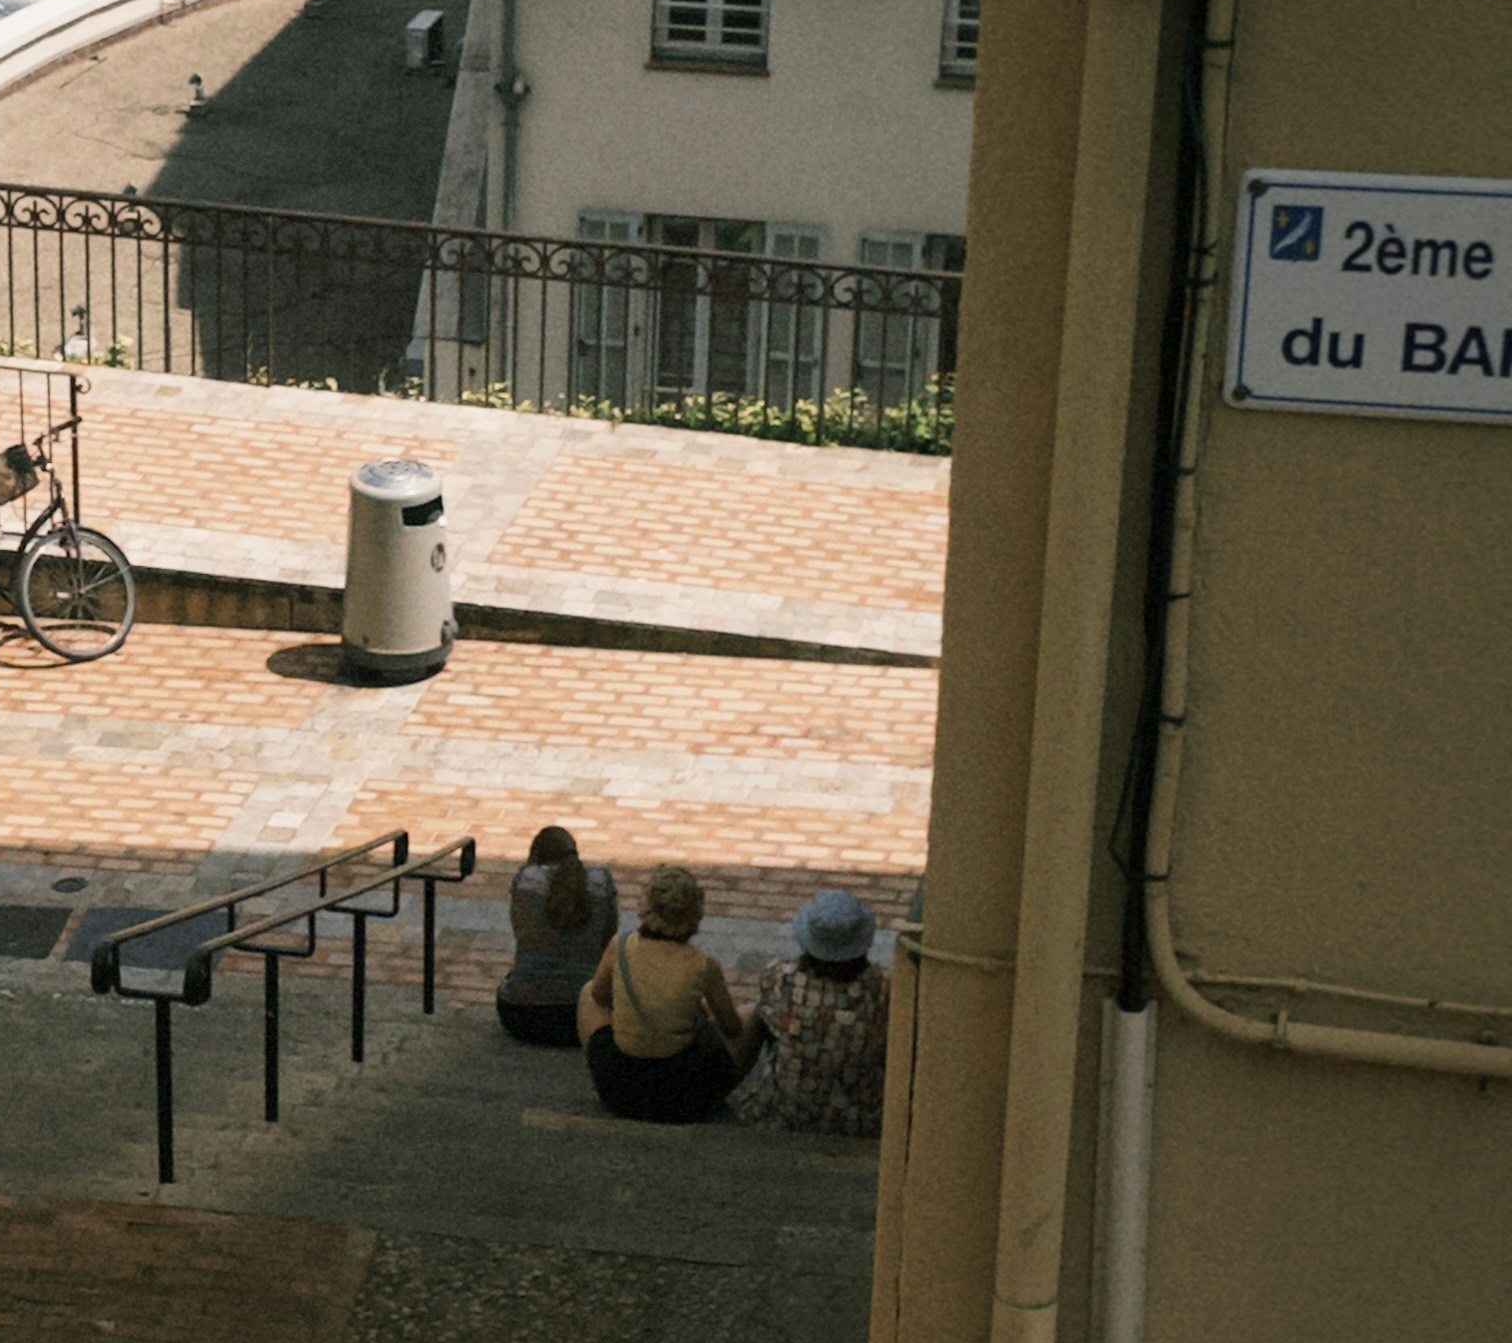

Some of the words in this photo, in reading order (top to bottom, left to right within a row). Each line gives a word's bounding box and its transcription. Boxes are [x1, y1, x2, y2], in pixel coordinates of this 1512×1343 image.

[1341, 221, 1494, 280] 2ème
[1281, 317, 1364, 369] du
[1401, 322, 1512, 378] BA
